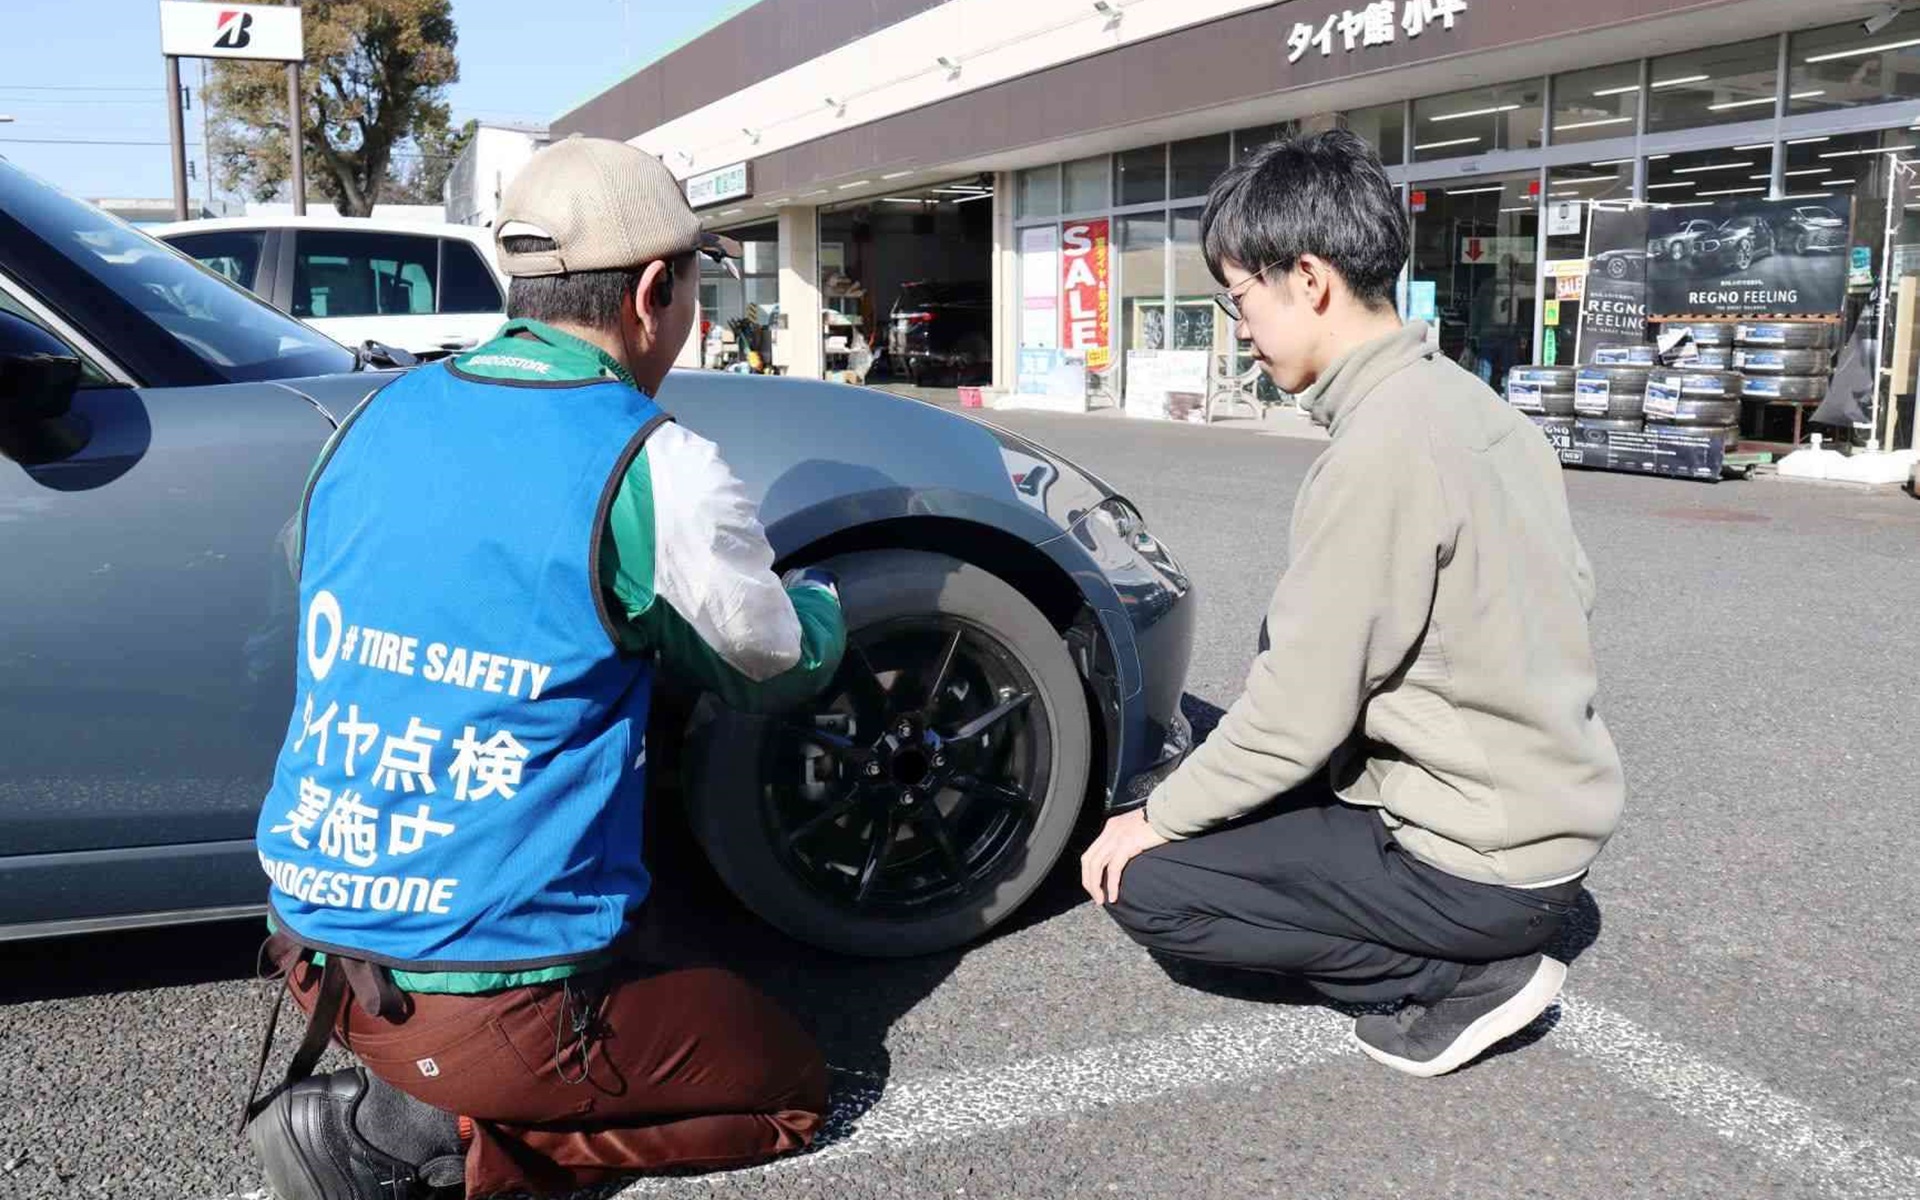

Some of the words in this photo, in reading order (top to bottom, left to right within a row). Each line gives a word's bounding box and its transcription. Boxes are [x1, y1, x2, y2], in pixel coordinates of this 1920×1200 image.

[1286, 1, 1395, 64] タイヤ館
[1064, 226, 1098, 350] SALE
[1688, 291, 1739, 304] REGNO
[1743, 289, 1798, 304] FEELING
[422, 641, 552, 701] SAFETY
[258, 849, 460, 914] RIDGESTONE
